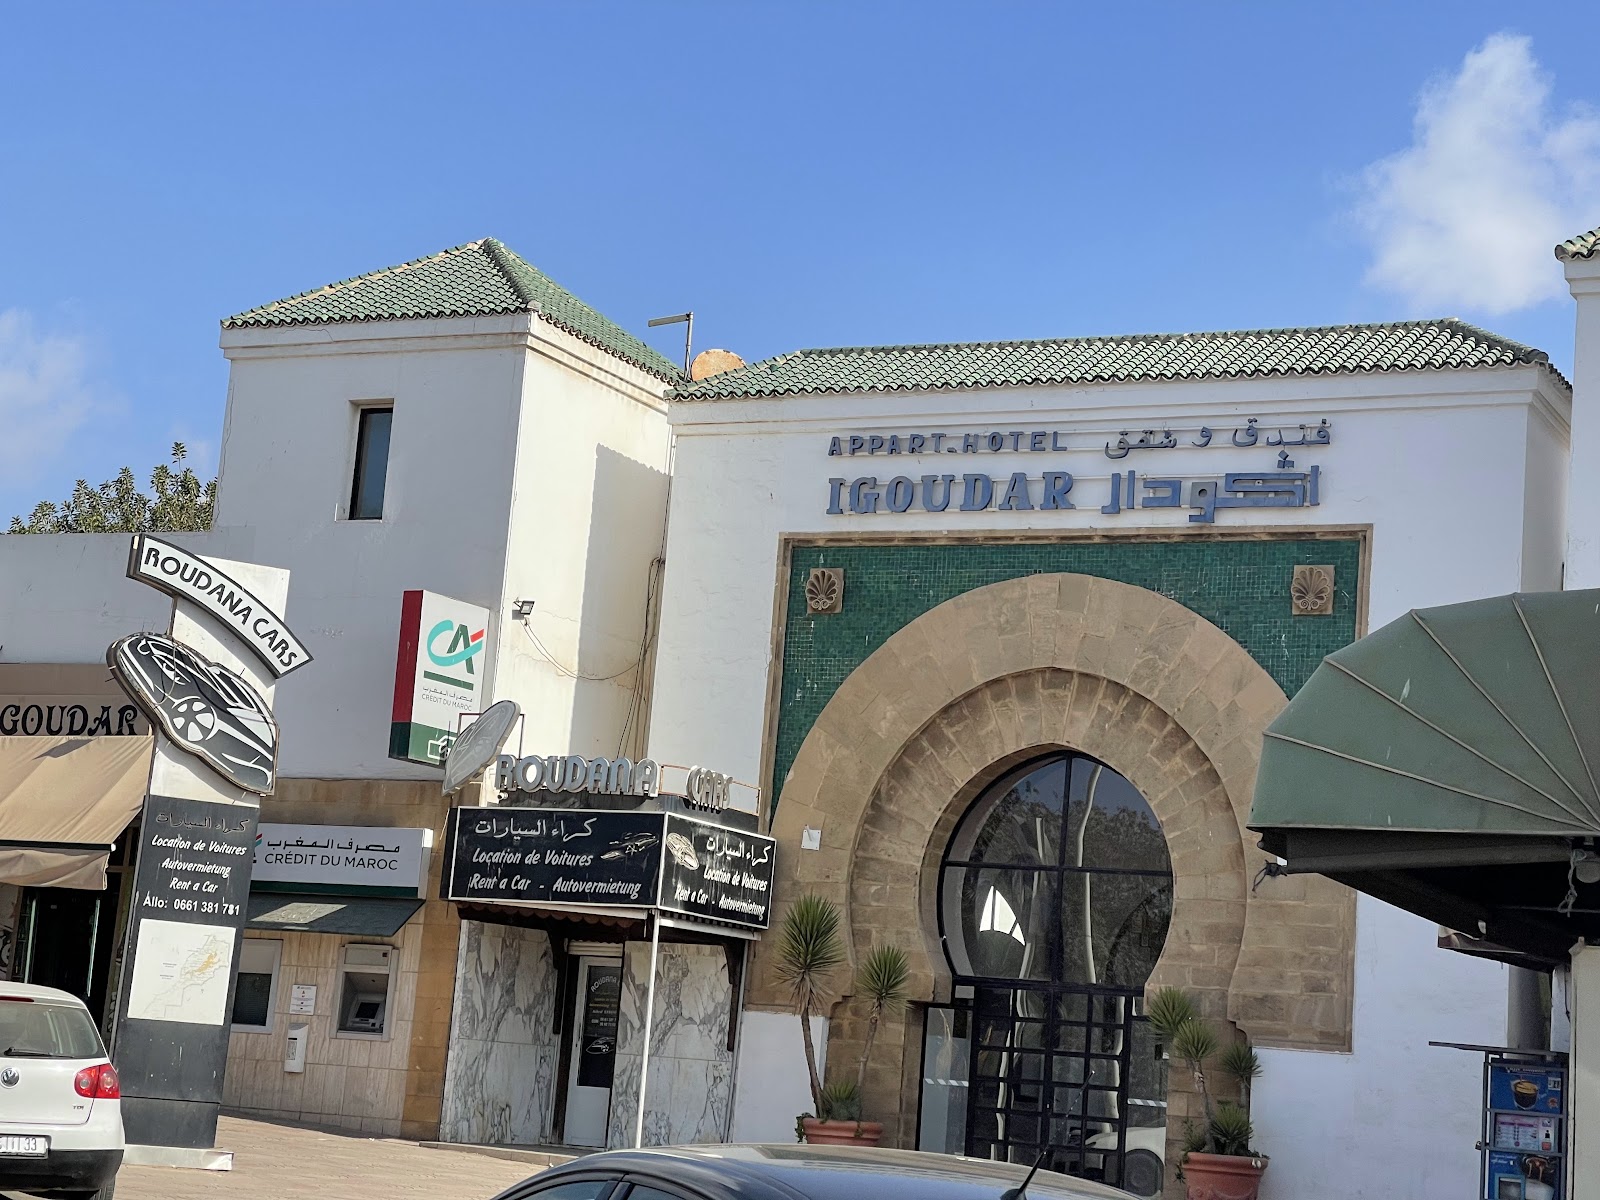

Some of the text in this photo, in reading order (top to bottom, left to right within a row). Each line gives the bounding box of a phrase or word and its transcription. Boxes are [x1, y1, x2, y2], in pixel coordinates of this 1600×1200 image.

[1104, 418, 1331, 460] فندق و شقق
[826, 471, 1077, 515] IGOUDAR
[144, 547, 298, 668] ROUDANA CARS
[442, 698, 452, 707] DU
[452, 701, 472, 712] MAROC
[0, 704, 138, 736] GOUDAR
[494, 754, 734, 810] ROUDANA CARS
[474, 817, 598, 842] كراء السيارات
[151, 834, 247, 856] Location de Voitures
[267, 837, 400, 853] مصرف المغرب
[472, 848, 594, 866] Location de Voitures
[706, 836, 772, 867] كراء السيارات
[161, 858, 232, 878] Autovermietung
[264, 851, 398, 870] CRÉDIT DU MAROC
[169, 877, 218, 893] Rent a Car
[470, 873, 498, 890] Rent
[499, 879, 507, 890] a
[511, 875, 531, 891] Car
[552, 876, 642, 900] Autovermietung
[703, 865, 768, 892] Location de Voitures
[143, 896, 168, 908] Allo:
[173, 898, 198, 911] 0661
[201, 901, 219, 914] 381
[674, 883, 690, 902] Rent
[690, 890, 696, 901] a
[697, 888, 709, 905] Car
[718, 894, 766, 921] Autovermietung
[24, 1136, 37, 1151] 33
